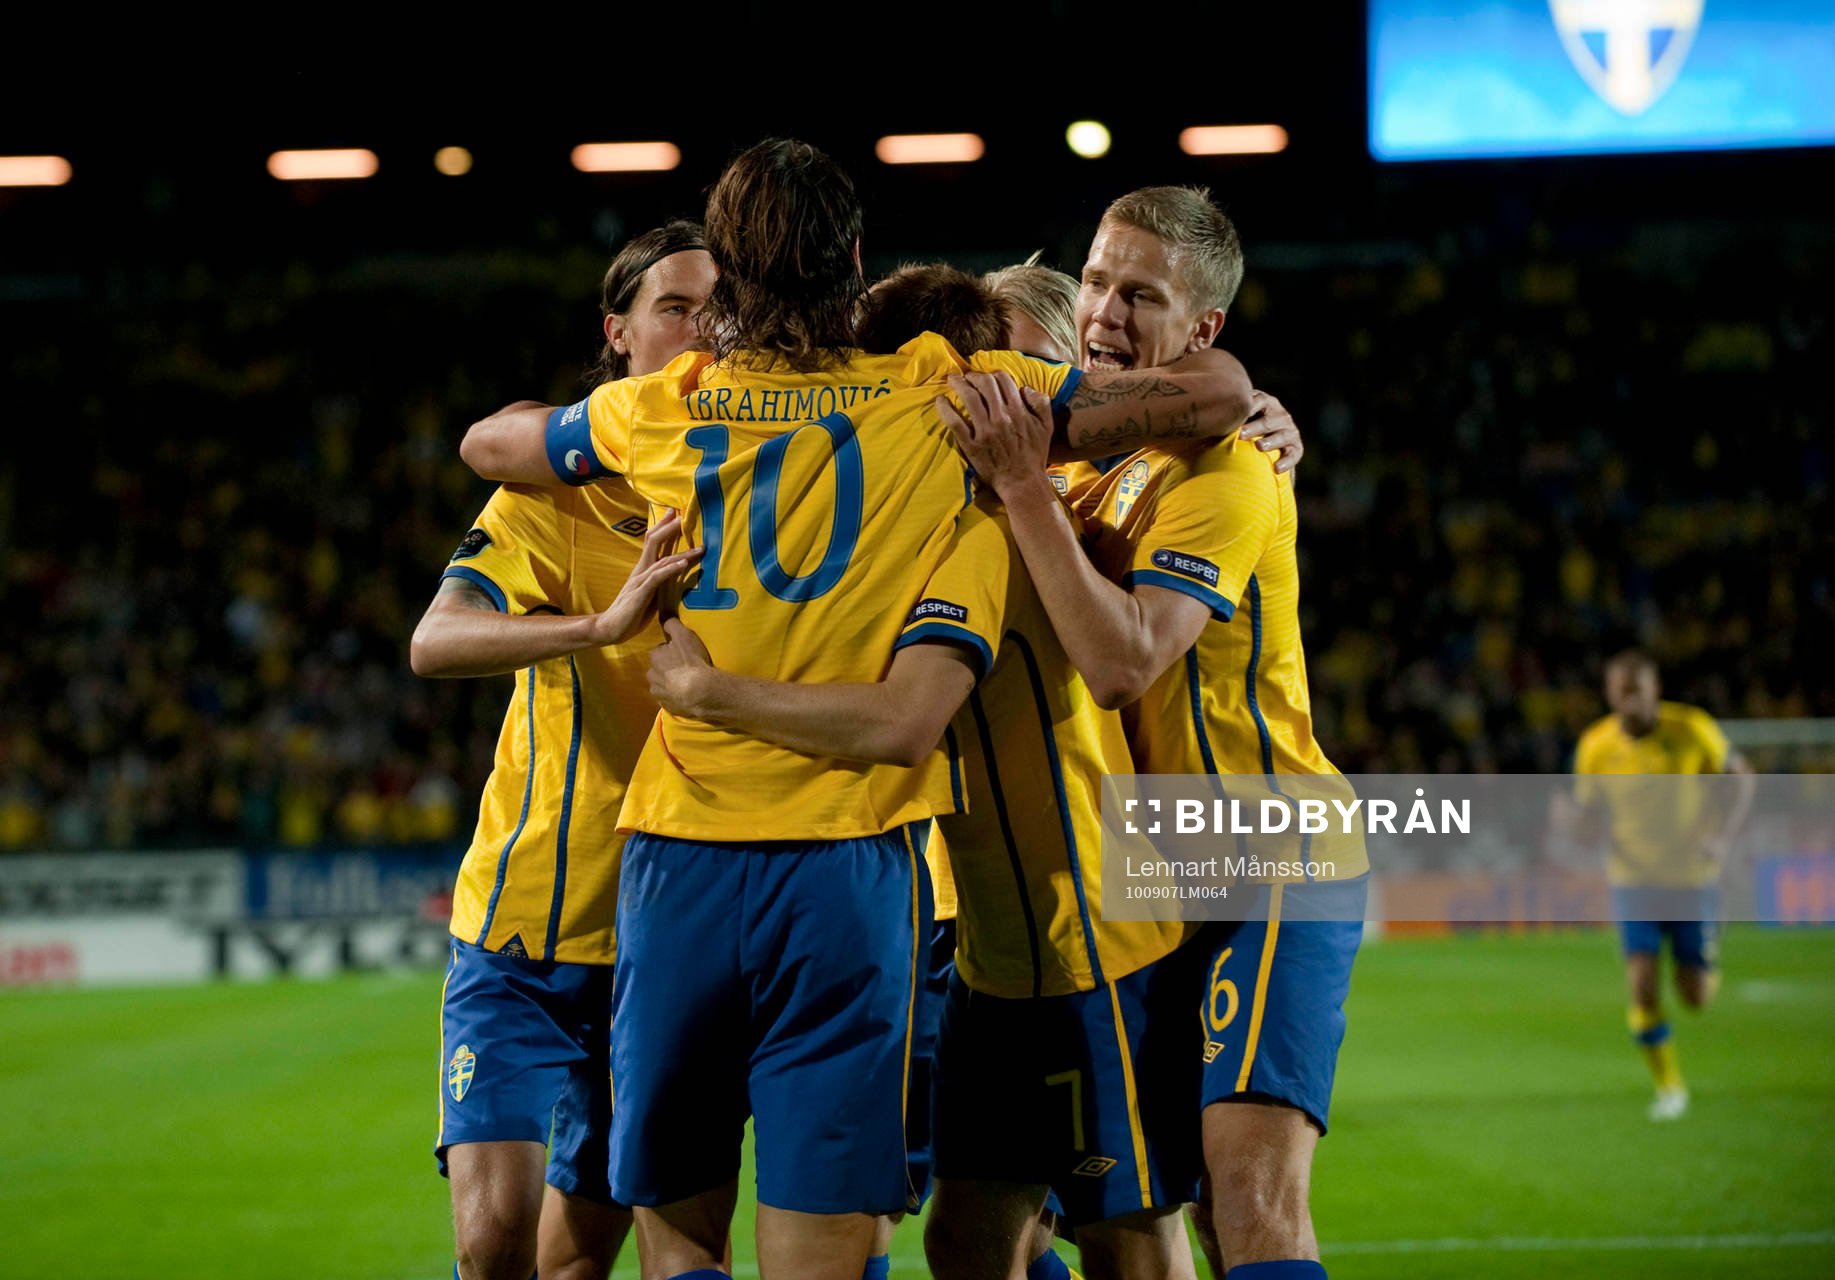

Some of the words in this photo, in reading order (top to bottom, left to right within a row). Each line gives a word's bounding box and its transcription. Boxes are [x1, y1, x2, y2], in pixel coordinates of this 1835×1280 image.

[682, 411, 864, 610] 10
[915, 603, 964, 618] RESPECT
[1174, 557, 1218, 582] RESPECT
[1209, 947, 1239, 1032] 6
[1045, 1068, 1085, 1151] 7
